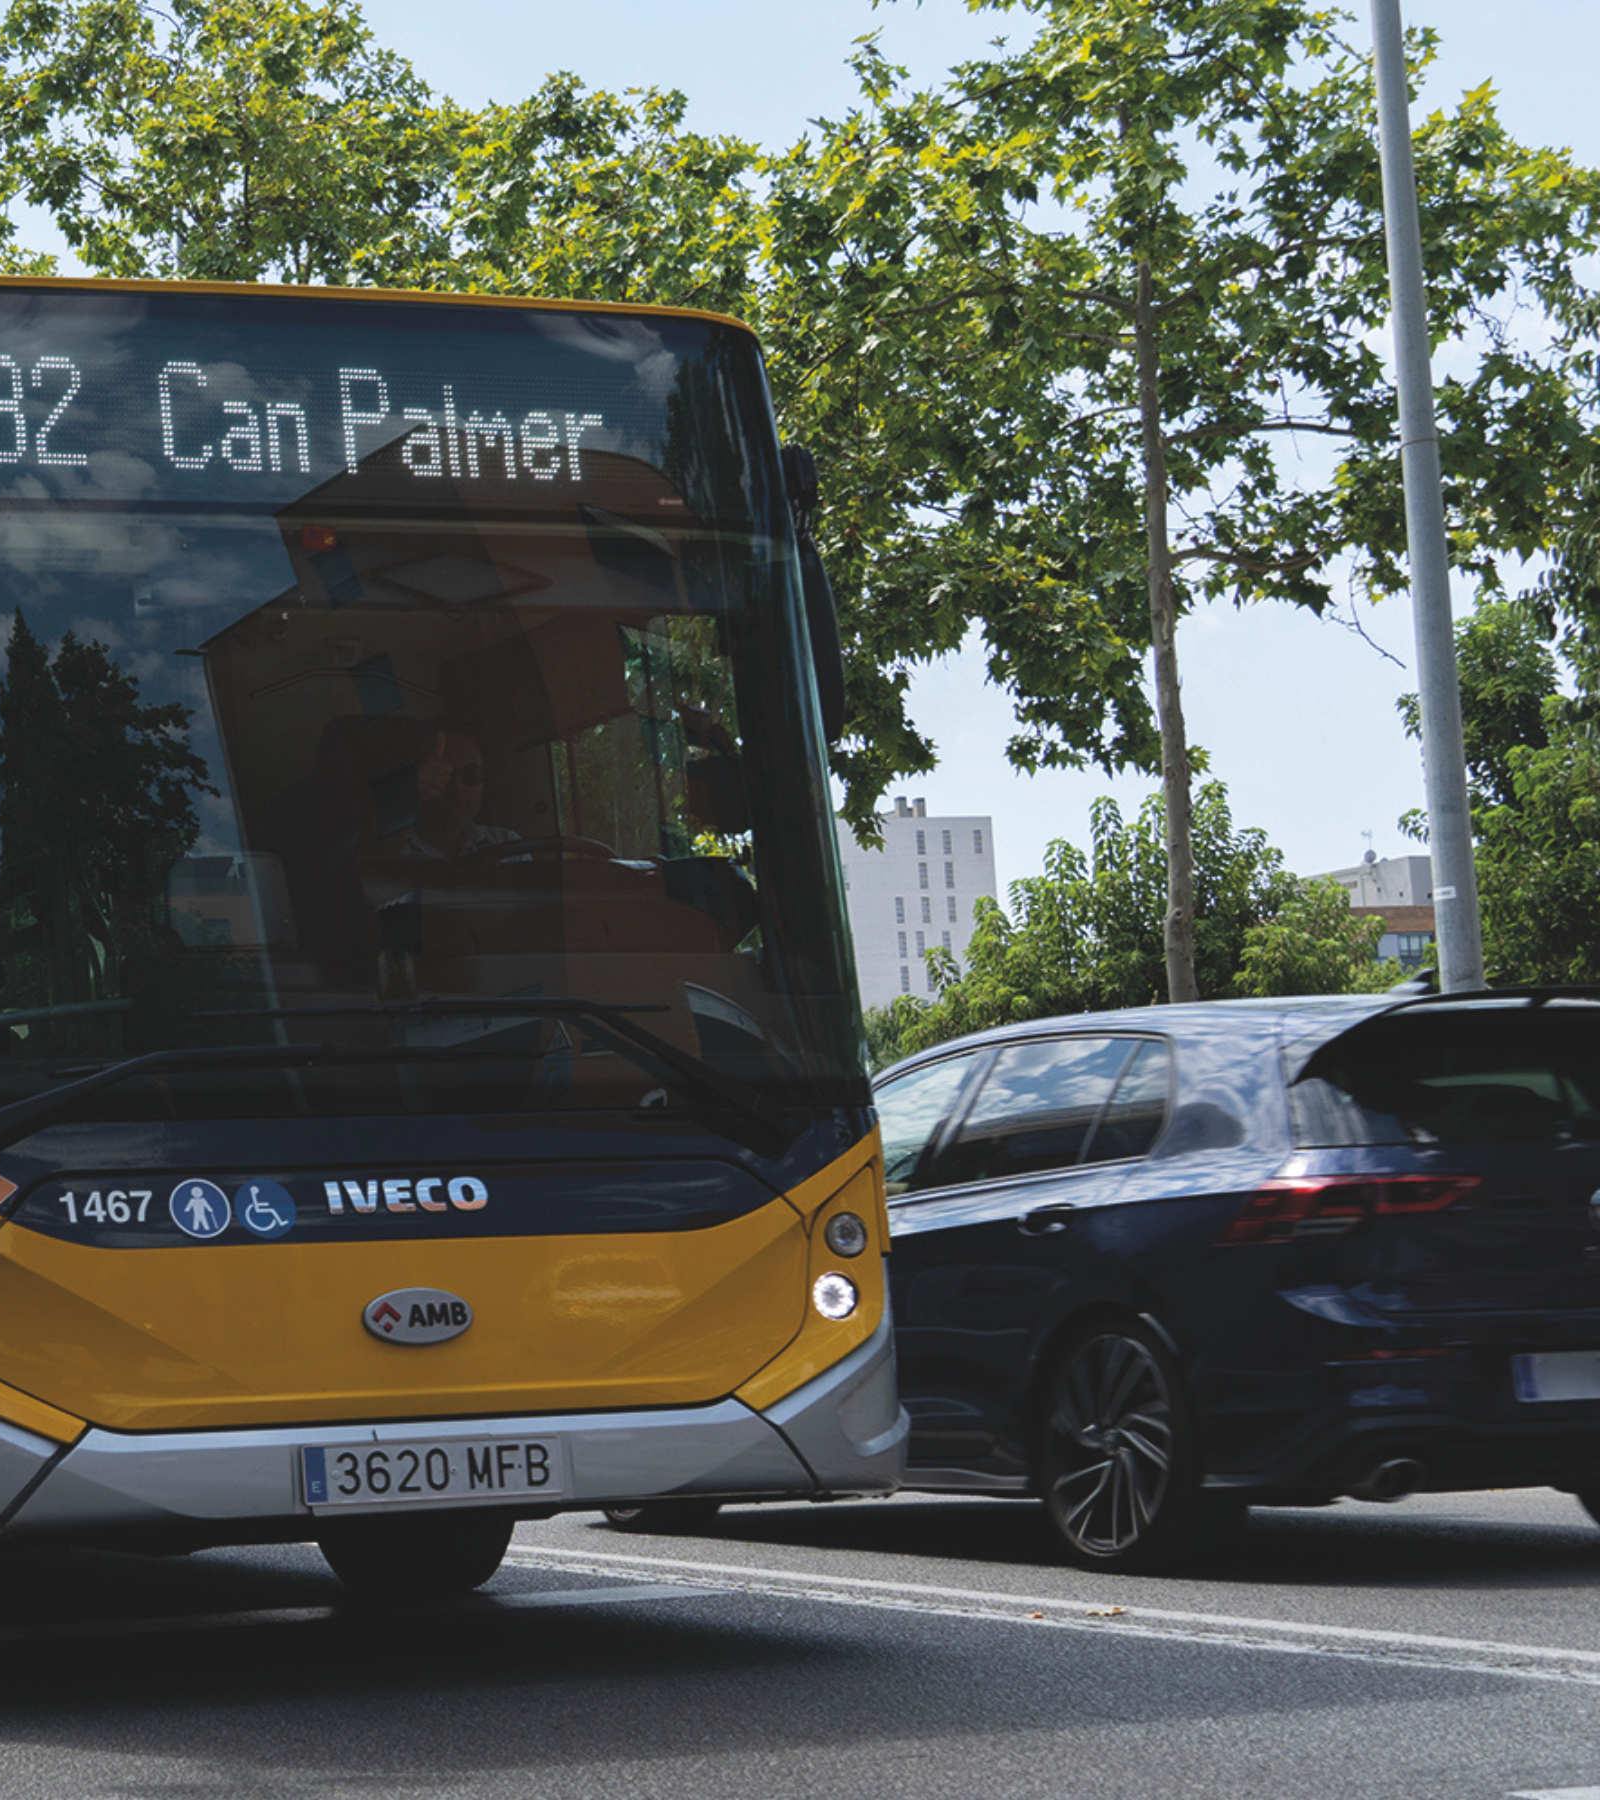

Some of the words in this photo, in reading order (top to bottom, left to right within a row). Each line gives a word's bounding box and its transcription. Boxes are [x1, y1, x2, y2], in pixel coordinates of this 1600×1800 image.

[158, 360, 310, 473] Can
[338, 366, 603, 481] Palmer
[58, 1189, 153, 1224] 1467
[323, 1175, 489, 1215] IVECO
[407, 1301, 469, 1328] AMB
[311, 1480, 322, 1494] E
[335, 1447, 450, 1496] 3620
[466, 1443, 551, 1490] MFB
